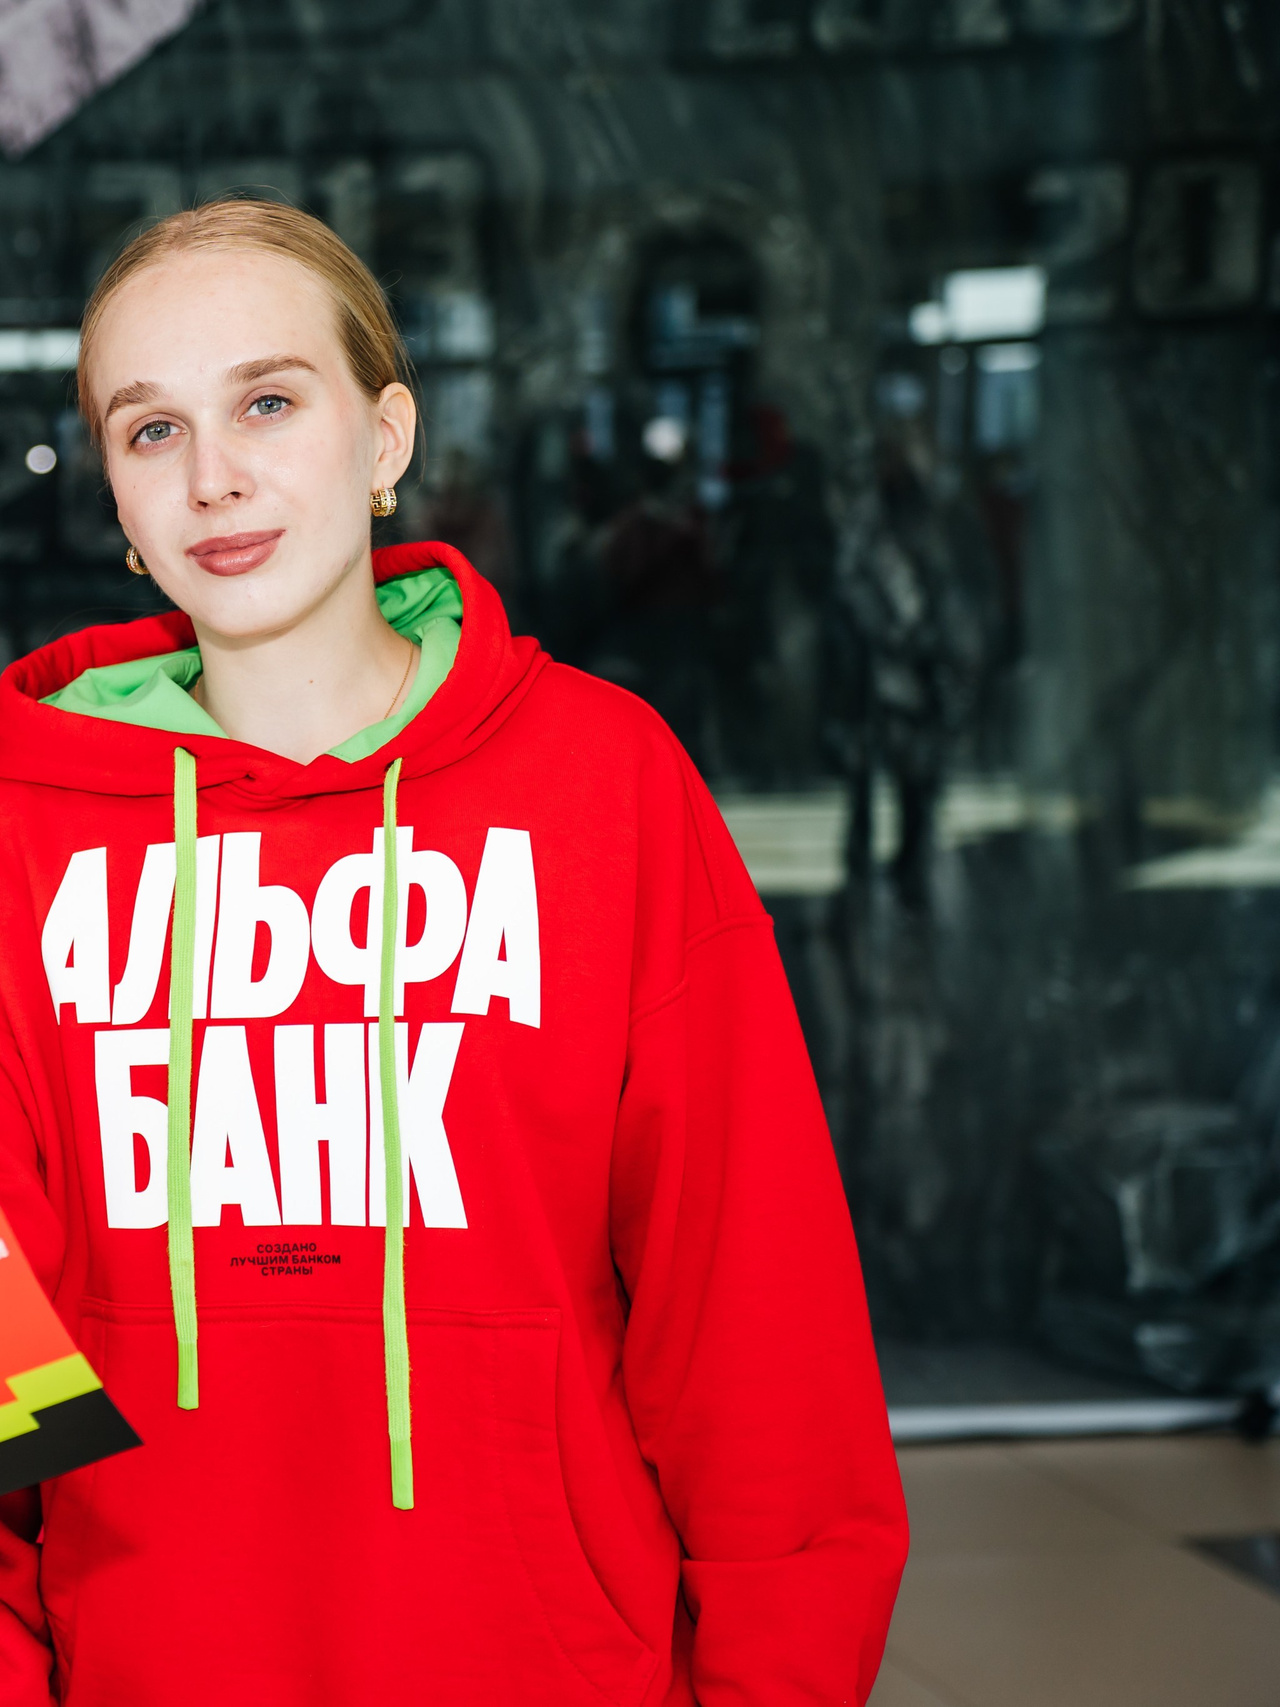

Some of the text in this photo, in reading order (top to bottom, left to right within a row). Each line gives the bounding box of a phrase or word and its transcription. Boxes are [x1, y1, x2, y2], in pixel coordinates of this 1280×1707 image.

[41, 825, 541, 1029] АЛЬФА
[94, 1021, 469, 1229] БАНК
[256, 1242, 317, 1255] СОЗДАНО
[230, 1254, 341, 1267] ЛУЧШИМ БАНКОМ
[261, 1266, 313, 1276] СТРАНЫ
